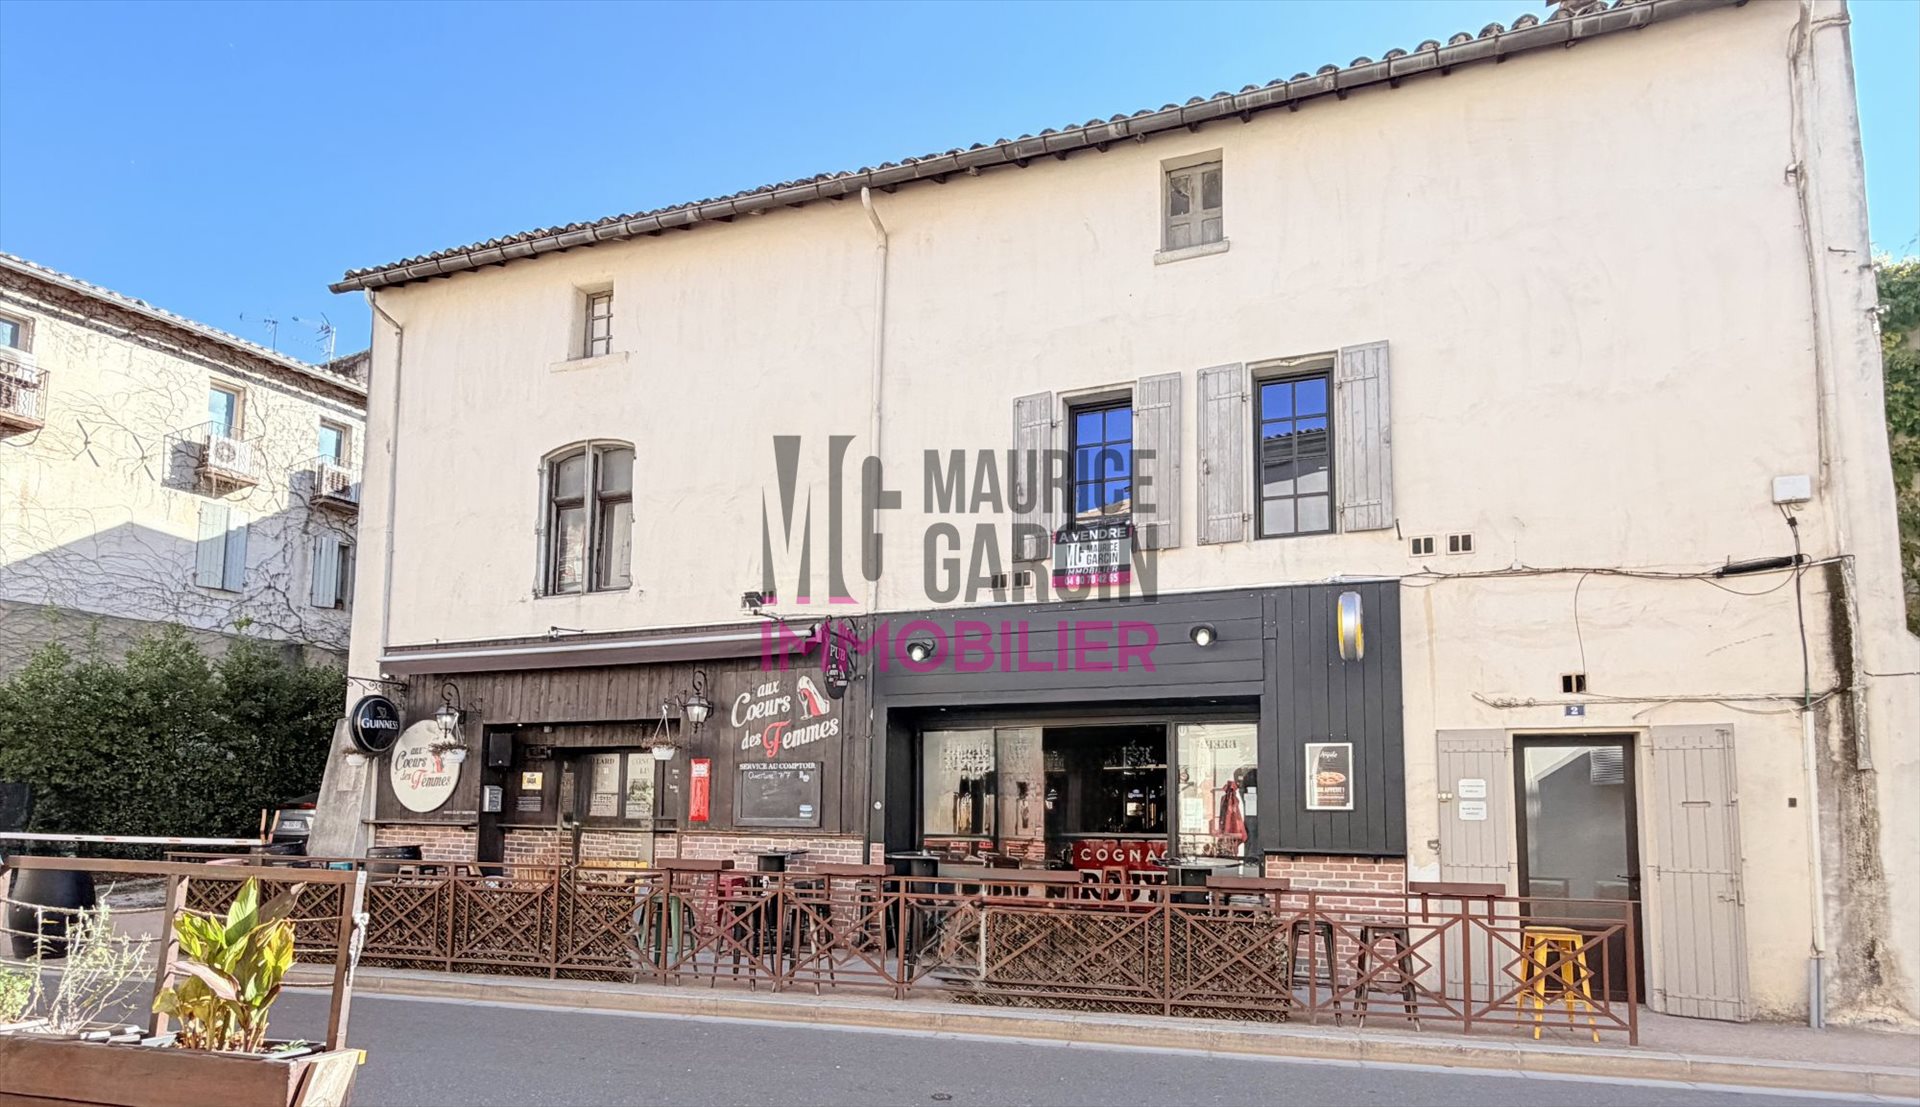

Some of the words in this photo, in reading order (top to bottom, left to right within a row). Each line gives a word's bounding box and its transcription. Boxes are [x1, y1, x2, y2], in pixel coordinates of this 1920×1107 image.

[1059, 532, 1069, 542] A
[1072, 527, 1126, 541] VENDRE
[1086, 551, 1119, 566] GARCIN
[830, 644, 846, 661] PUB
[757, 680, 780, 697] aux
[731, 692, 791, 728] Coeurs
[361, 718, 399, 730] GUINNESS
[741, 729, 762, 750] des
[762, 718, 839, 758] Femmes
[395, 750, 428, 771] Coeurs
[768, 762, 778, 770] AU
[779, 762, 816, 770] COMPTOIR
[411, 769, 452, 790] Femmes
